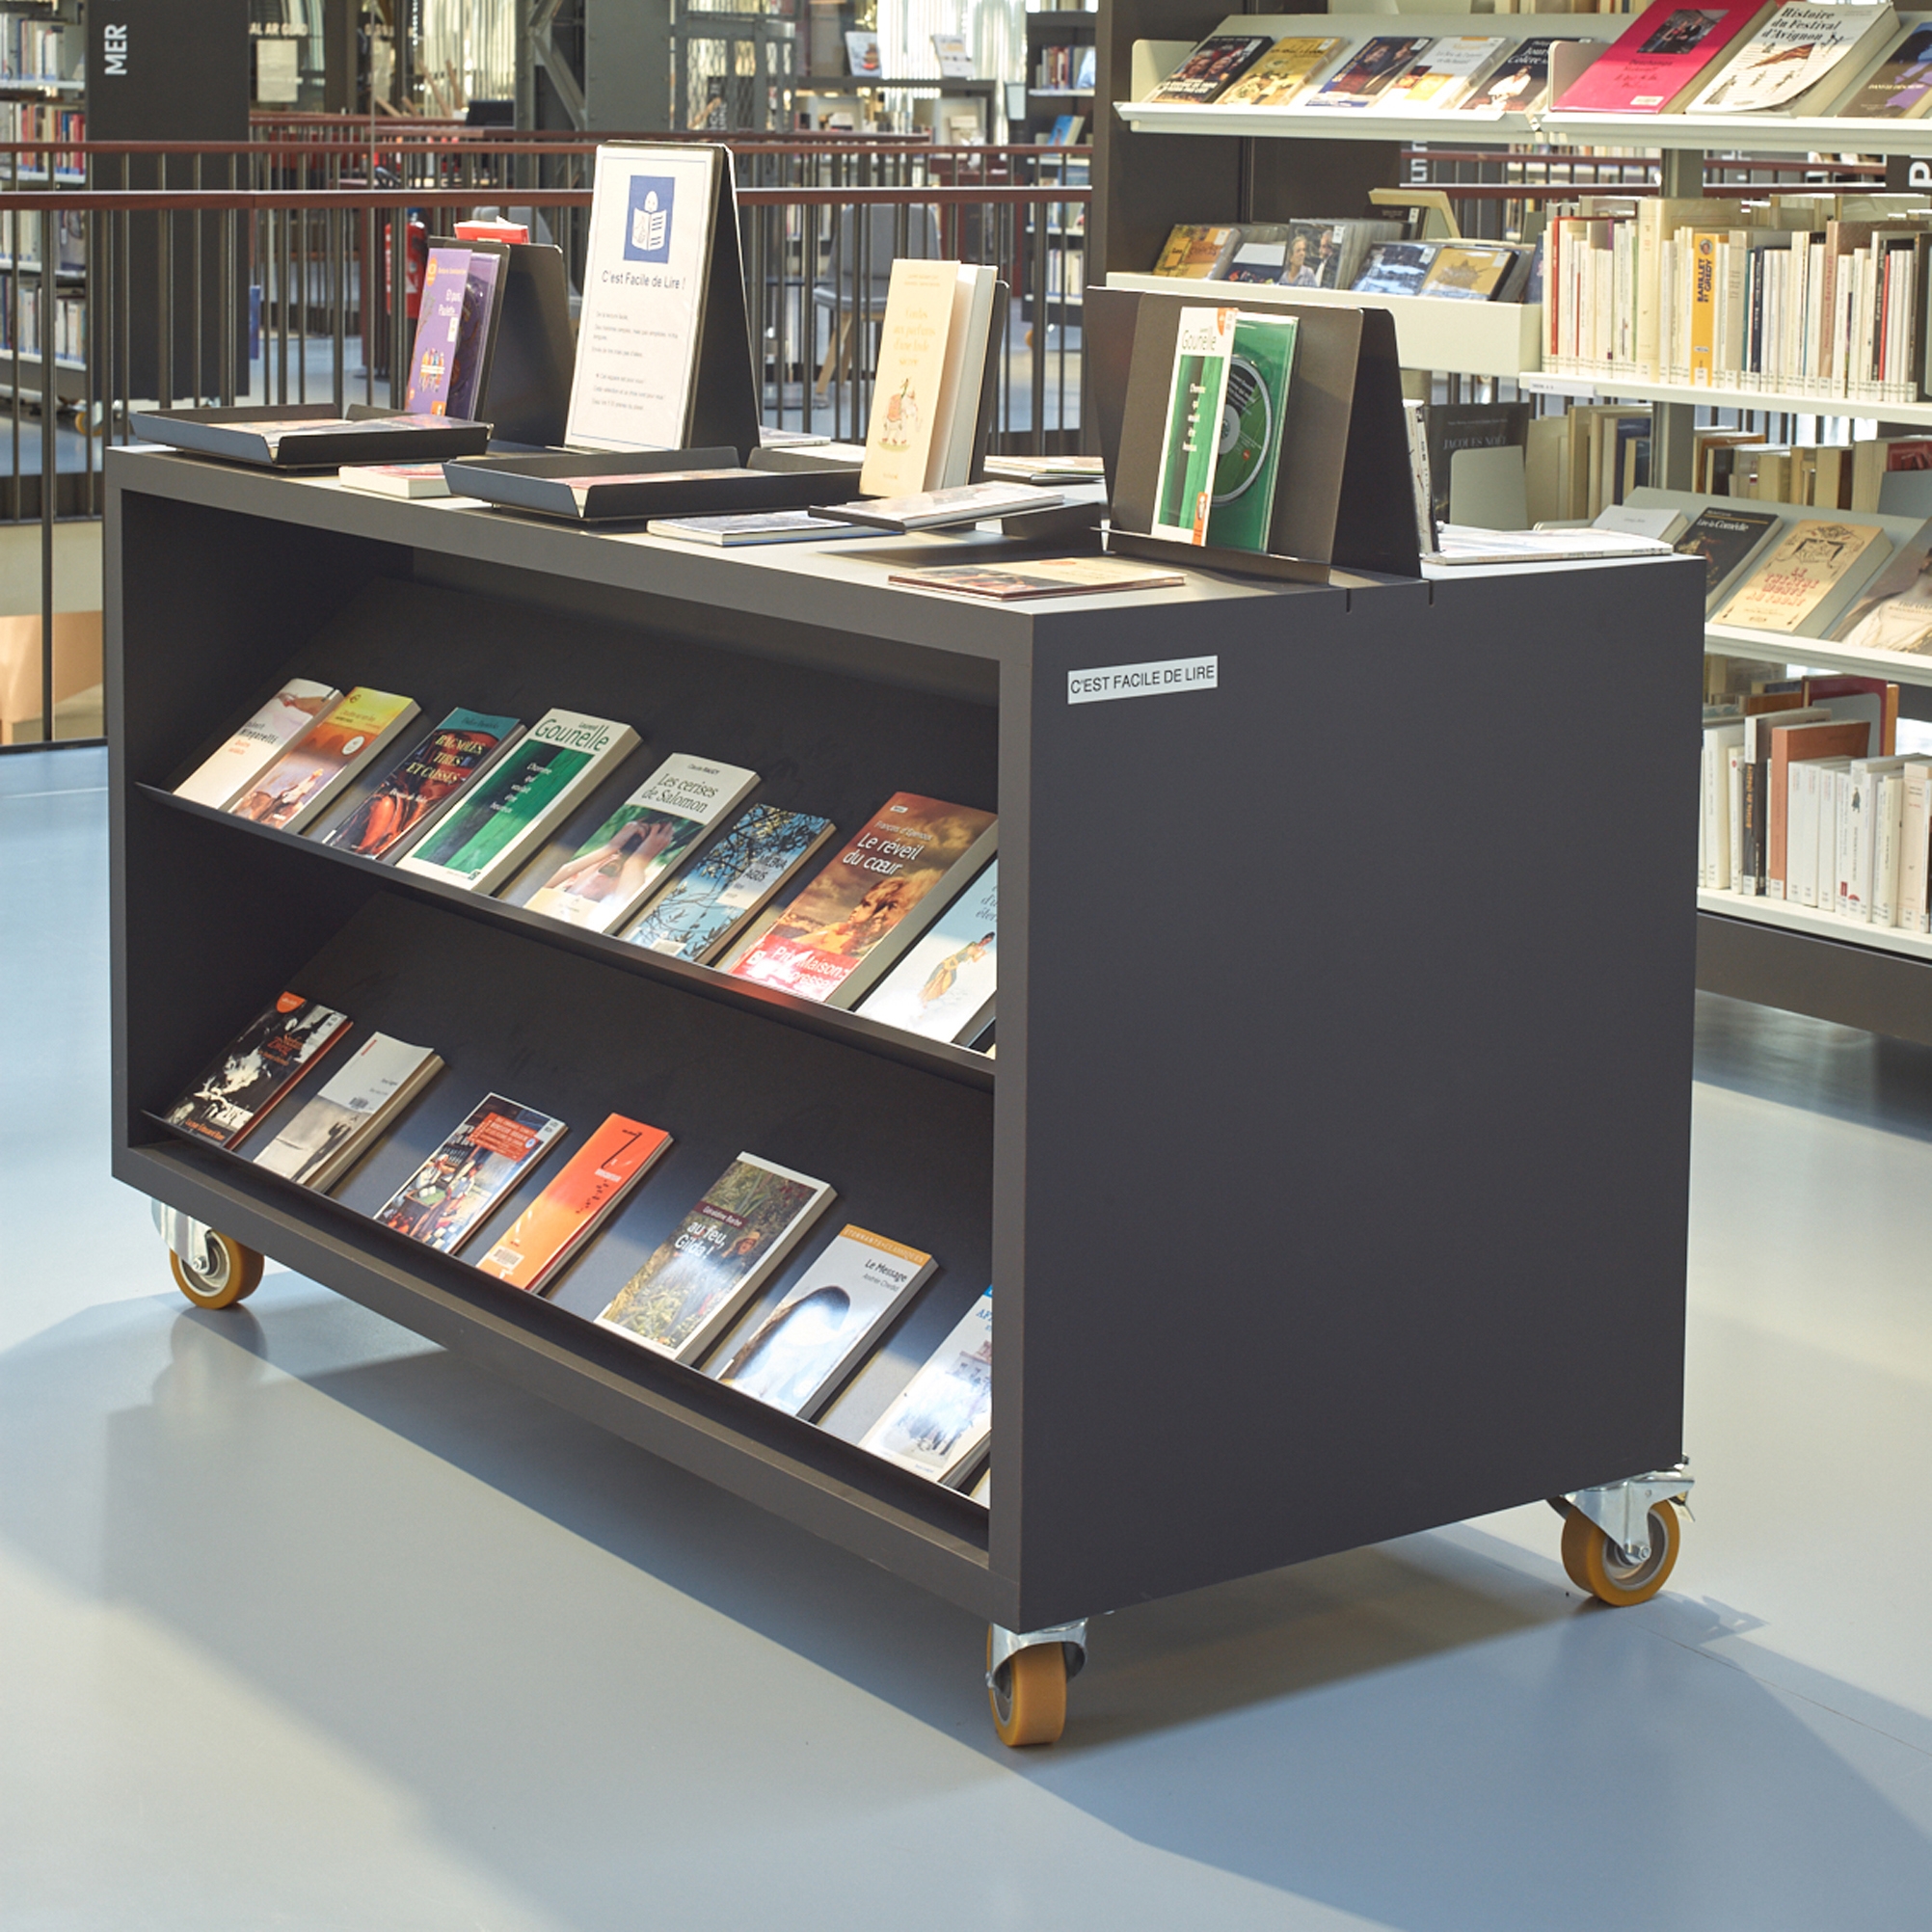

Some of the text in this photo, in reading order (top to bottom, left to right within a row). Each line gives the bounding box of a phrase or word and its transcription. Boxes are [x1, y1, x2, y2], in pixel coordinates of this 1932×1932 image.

[1771, 19, 1842, 31] du Festival
[1782, 8, 1835, 19] Histoire
[1761, 29, 1823, 42] d'Avignon
[104, 24, 127, 76] MER
[602, 270, 624, 284] C'est
[626, 272, 650, 286] Facile
[652, 275, 662, 287] de
[664, 276, 680, 289] Lire
[1697, 258, 1705, 302] BARILLET
[1070, 664, 1215, 694] C'EST FACILE DE LIRE
[535, 718, 609, 751] Gounelle
[657, 773, 720, 798] Les cerises
[641, 786, 708, 814] de Salomon
[857, 831, 925, 861] Le réveil
[842, 848, 903, 875] du cœur
[675, 1234, 708, 1258] Gilda
[686, 1221, 728, 1250] au feu,
[865, 1258, 908, 1283] Le Message
